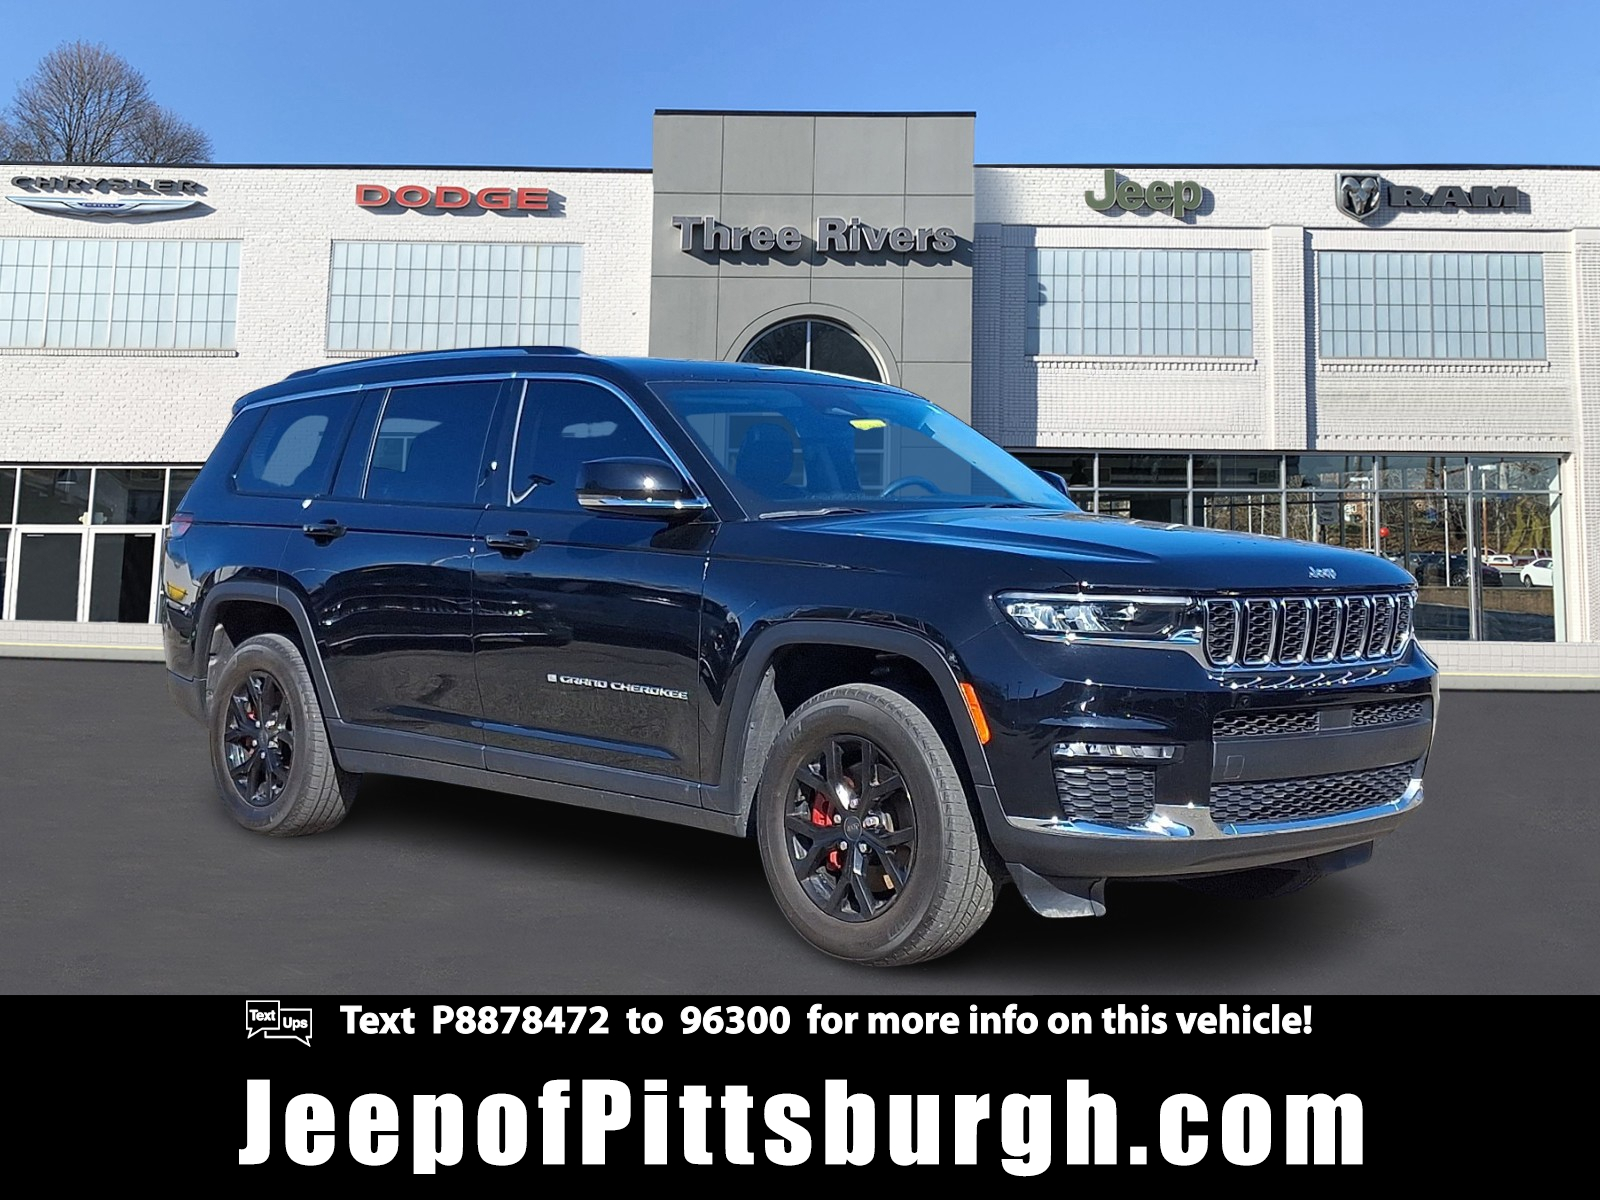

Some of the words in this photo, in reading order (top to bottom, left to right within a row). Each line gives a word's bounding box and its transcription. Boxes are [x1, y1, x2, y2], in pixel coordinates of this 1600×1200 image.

[11, 175, 199, 193] CHRYSLER
[355, 183, 550, 210] DODGE
[1084, 168, 1202, 218] Jeep
[1389, 185, 1520, 208] RAM
[671, 215, 803, 252] Three
[816, 216, 958, 253] Rivers
[559, 675, 608, 689] GRAND
[610, 682, 689, 700] CHEROKEE
